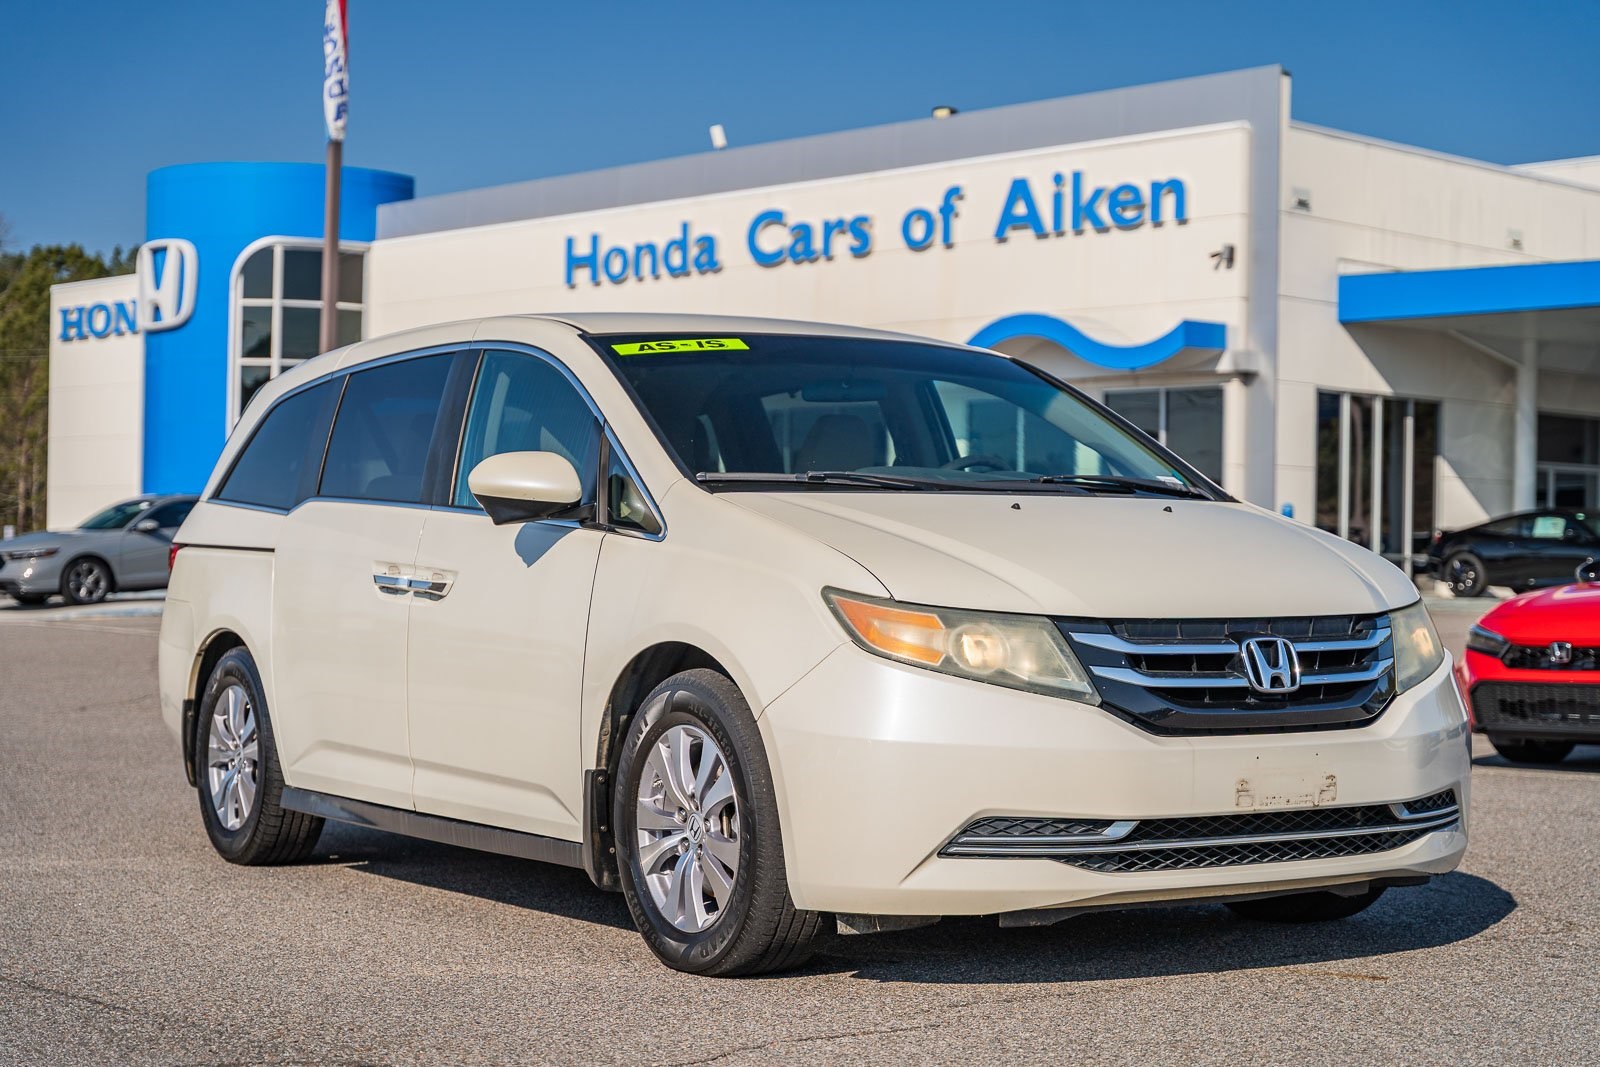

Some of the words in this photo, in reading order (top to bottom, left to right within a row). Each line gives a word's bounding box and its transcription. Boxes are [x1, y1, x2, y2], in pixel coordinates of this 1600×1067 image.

[565, 222, 720, 288] Honda
[747, 208, 872, 267] Cars
[901, 185, 963, 252] of
[994, 170, 1188, 244] Aiken
[687, 703, 736, 768] ALL-SEASON
